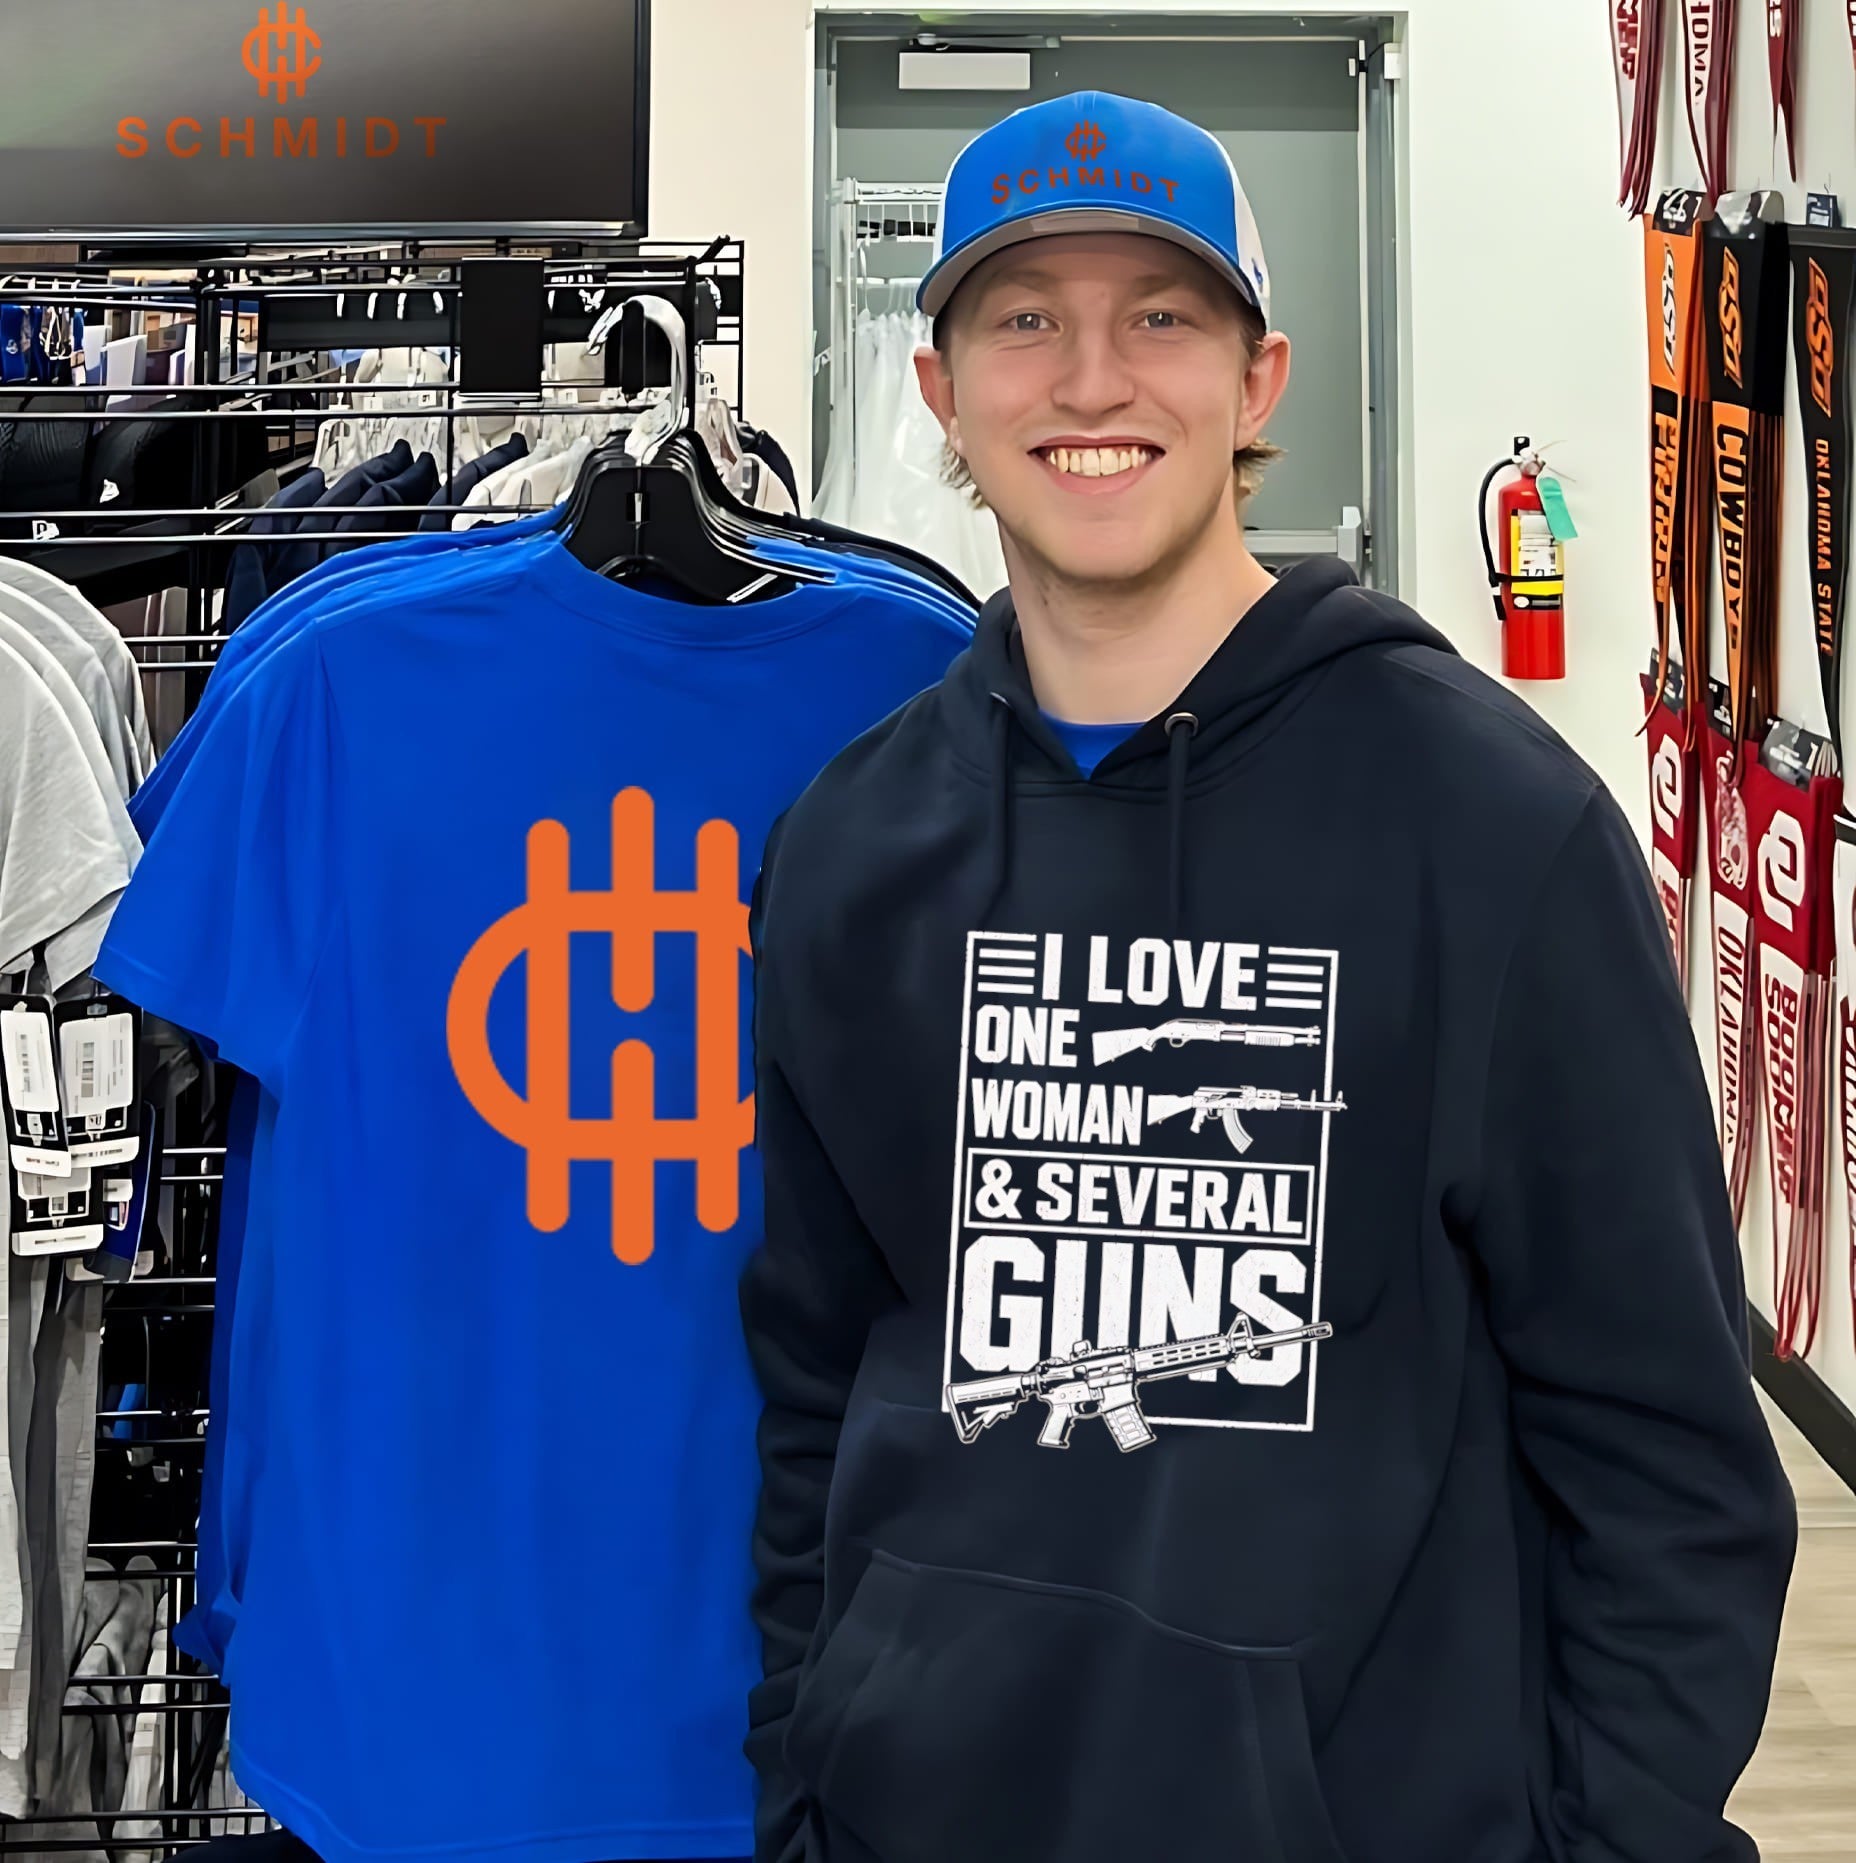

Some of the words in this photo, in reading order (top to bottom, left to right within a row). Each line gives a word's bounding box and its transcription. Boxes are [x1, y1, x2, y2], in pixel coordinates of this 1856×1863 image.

[116, 115, 447, 159] SCHMIDT
[991, 166, 1179, 205] SCHMIDT
[1815, 438, 1833, 571] OKLAHOMA
[1042, 933, 1063, 1001] I
[1088, 936, 1260, 1011] LOVE
[975, 1004, 1080, 1068] ONE
[971, 1078, 1144, 1146] WOMAN
[975, 1158, 1023, 1220] &
[1036, 1162, 1304, 1234] SEVERAL
[959, 1235, 1307, 1387] GUNS
